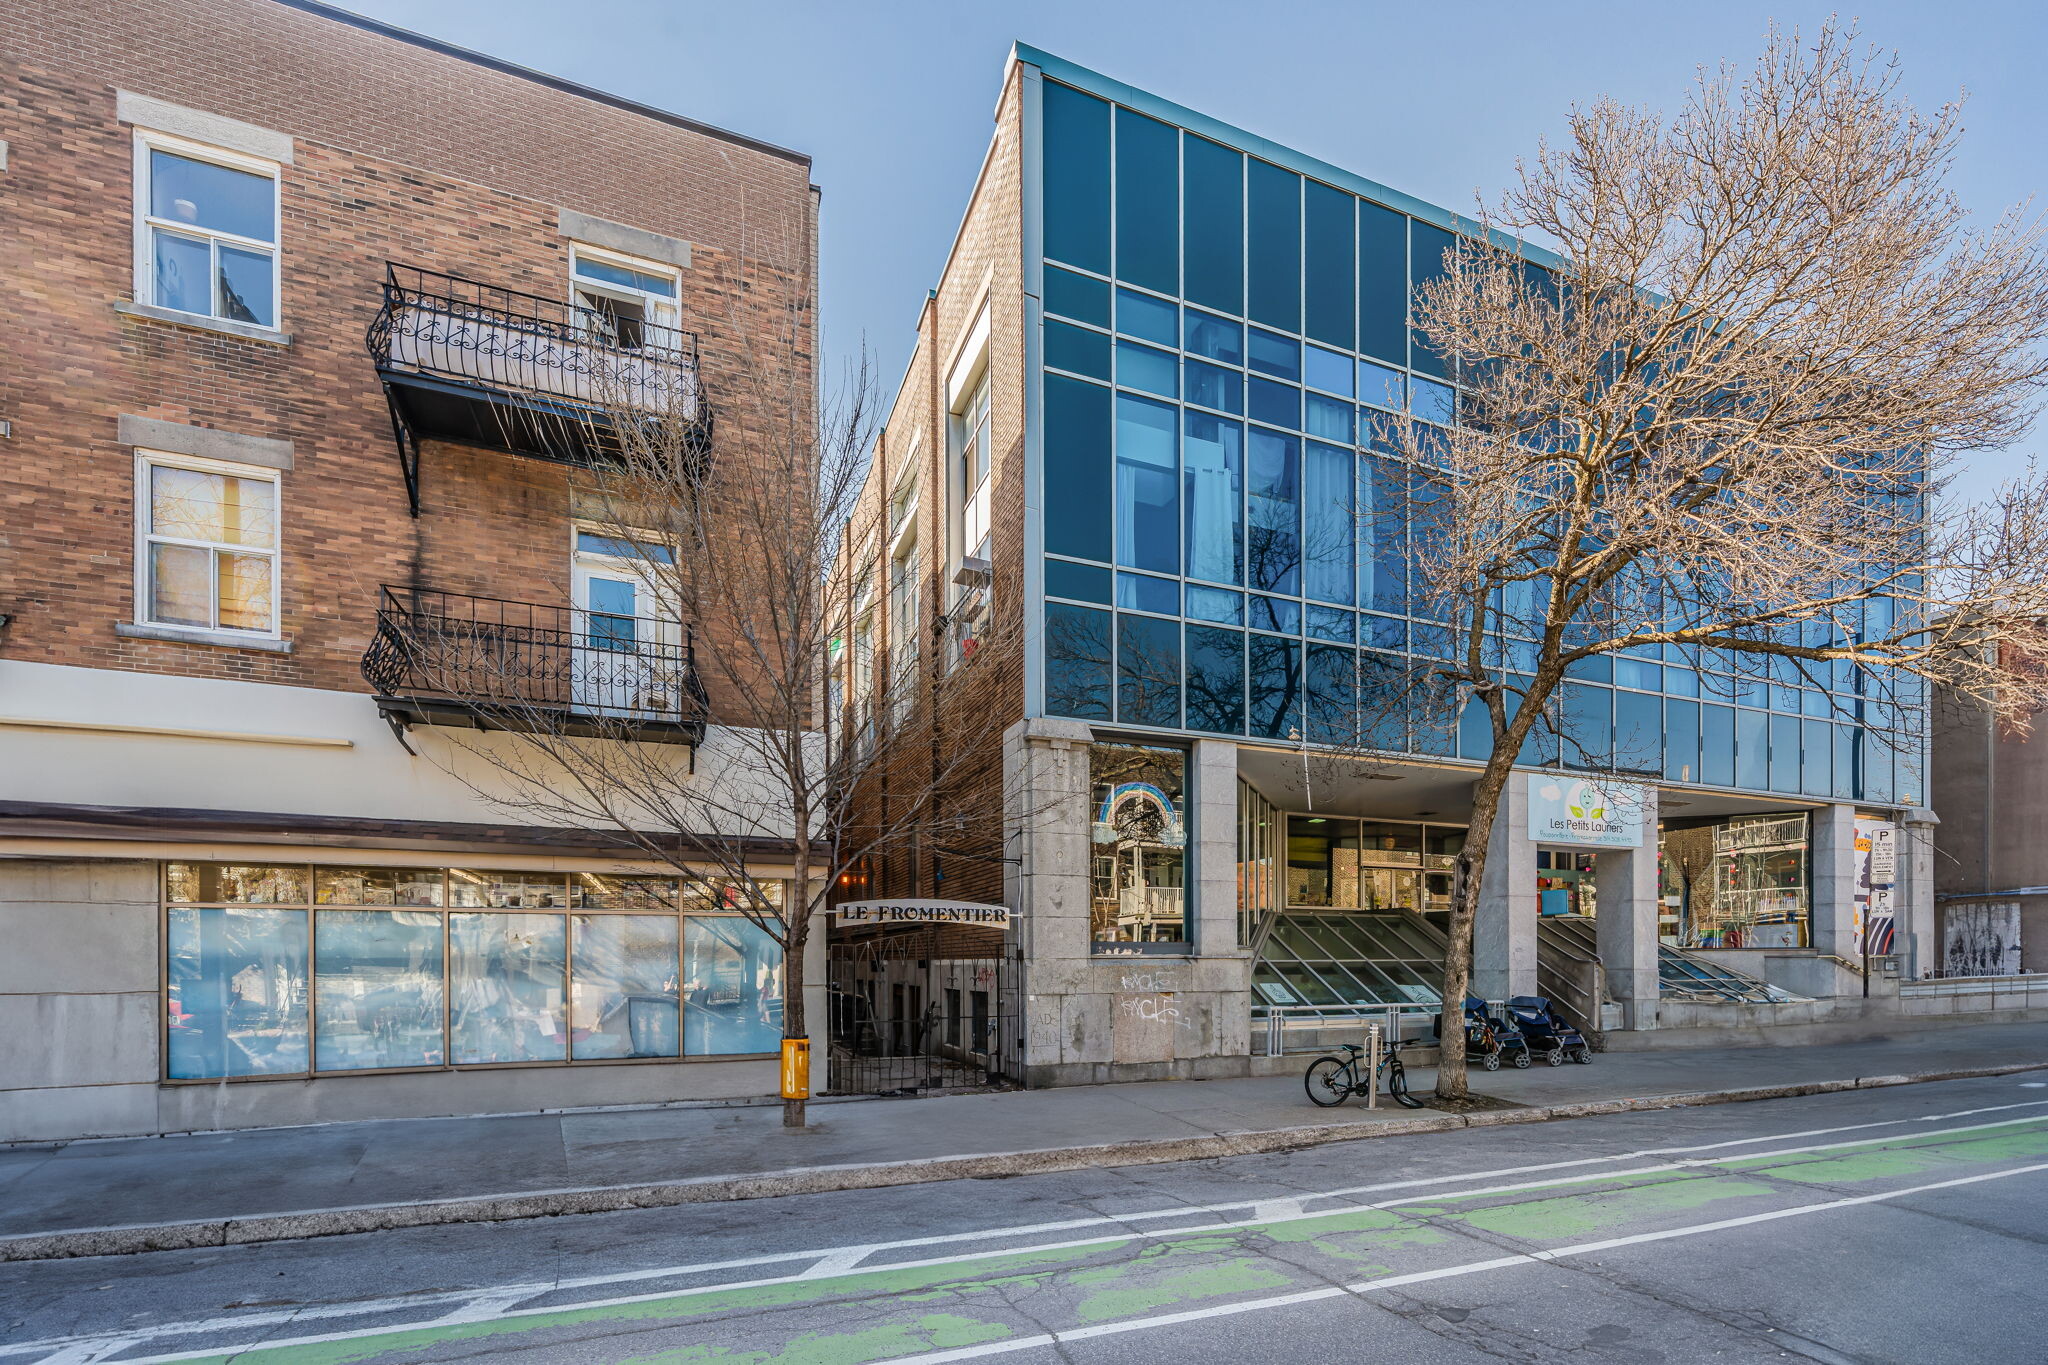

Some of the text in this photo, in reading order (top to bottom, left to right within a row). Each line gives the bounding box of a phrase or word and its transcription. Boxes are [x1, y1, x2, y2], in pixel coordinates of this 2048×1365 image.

[1550, 818, 1565, 830] Les
[1566, 820, 1590, 832] Petits
[1880, 831, 1888, 841] P
[1879, 892, 1888, 902] P
[843, 906, 1006, 922] LE FROMENTIER
